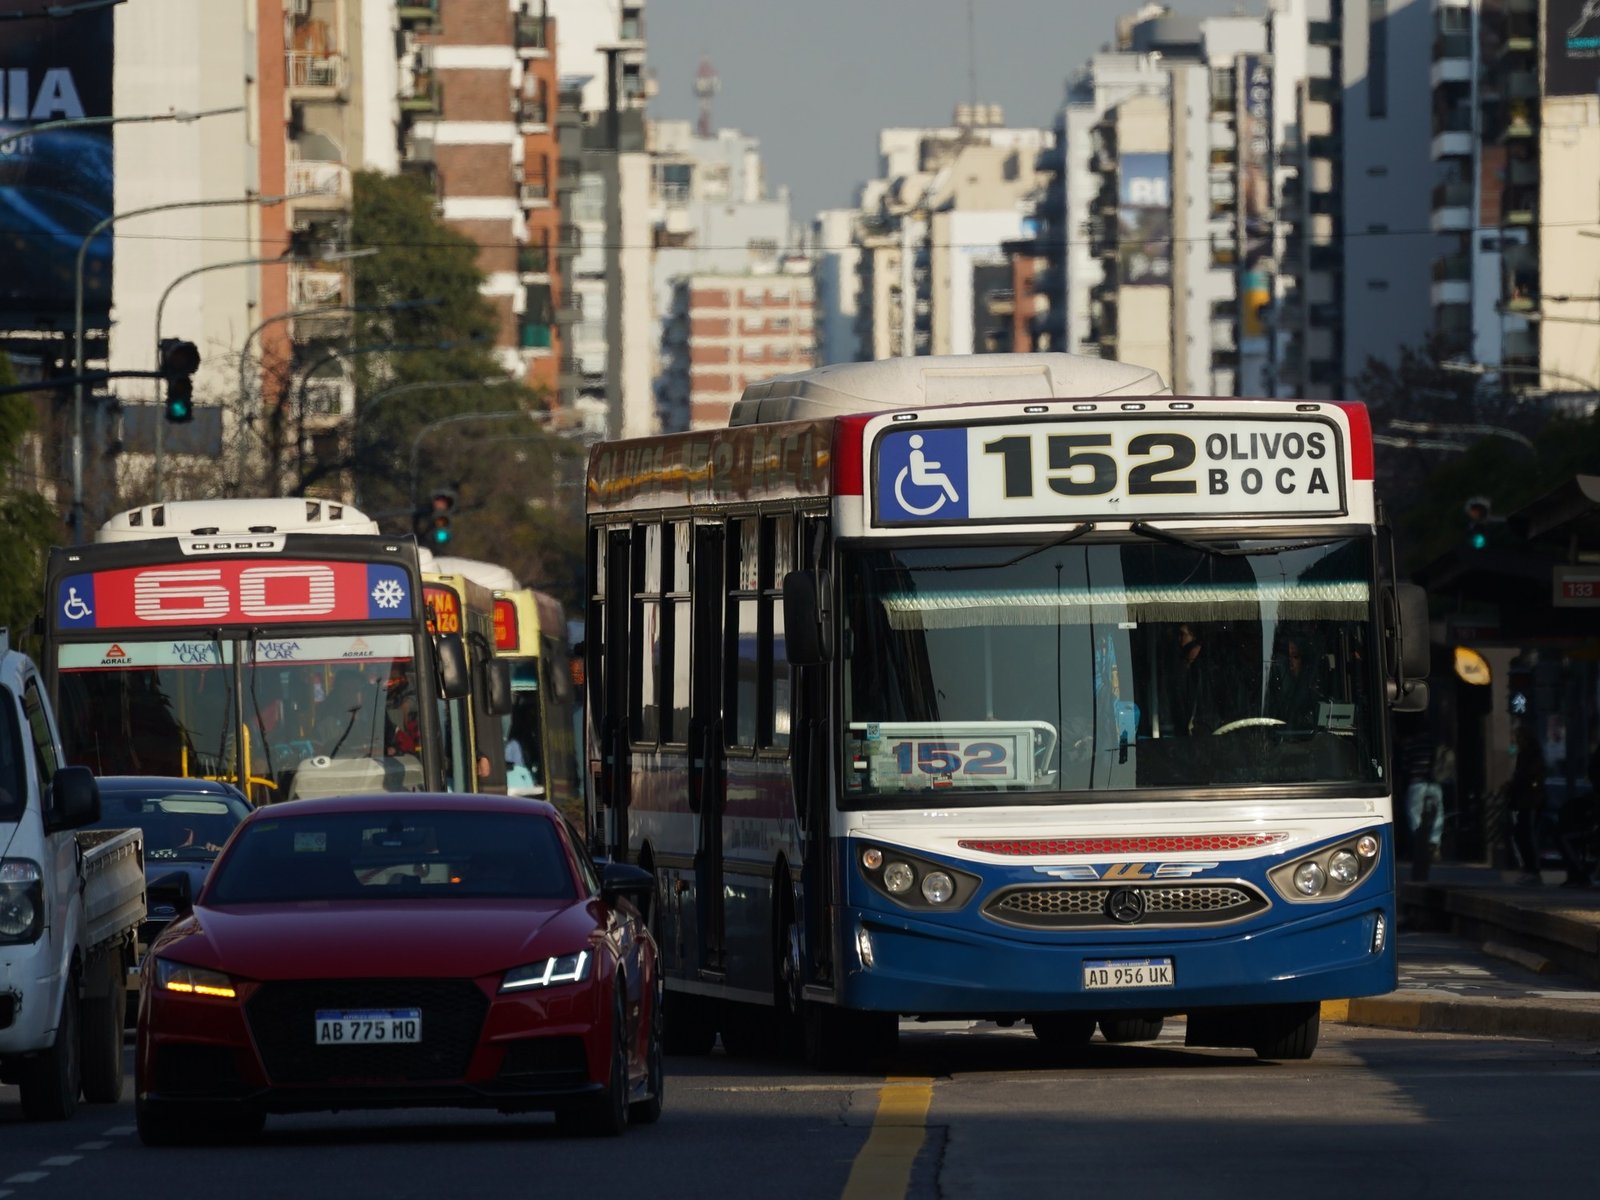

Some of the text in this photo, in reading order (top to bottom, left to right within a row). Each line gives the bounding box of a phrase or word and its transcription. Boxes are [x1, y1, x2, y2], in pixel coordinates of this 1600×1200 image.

[0, 67, 86, 119] IA
[983, 432, 1326, 499] 152 OLIVOS
[1208, 467, 1330, 495] BOCA
[134, 565, 336, 620] 60
[1568, 583, 1593, 597] 133
[258, 641, 300, 652] MEGA
[264, 650, 294, 660] CAR
[101, 657, 132, 665] AGRALE
[179, 653, 210, 664] CAR
[892, 741, 1007, 775] 152
[1089, 967, 1169, 986] AD 956 UK
[321, 1020, 416, 1041] AB 775 MQ
